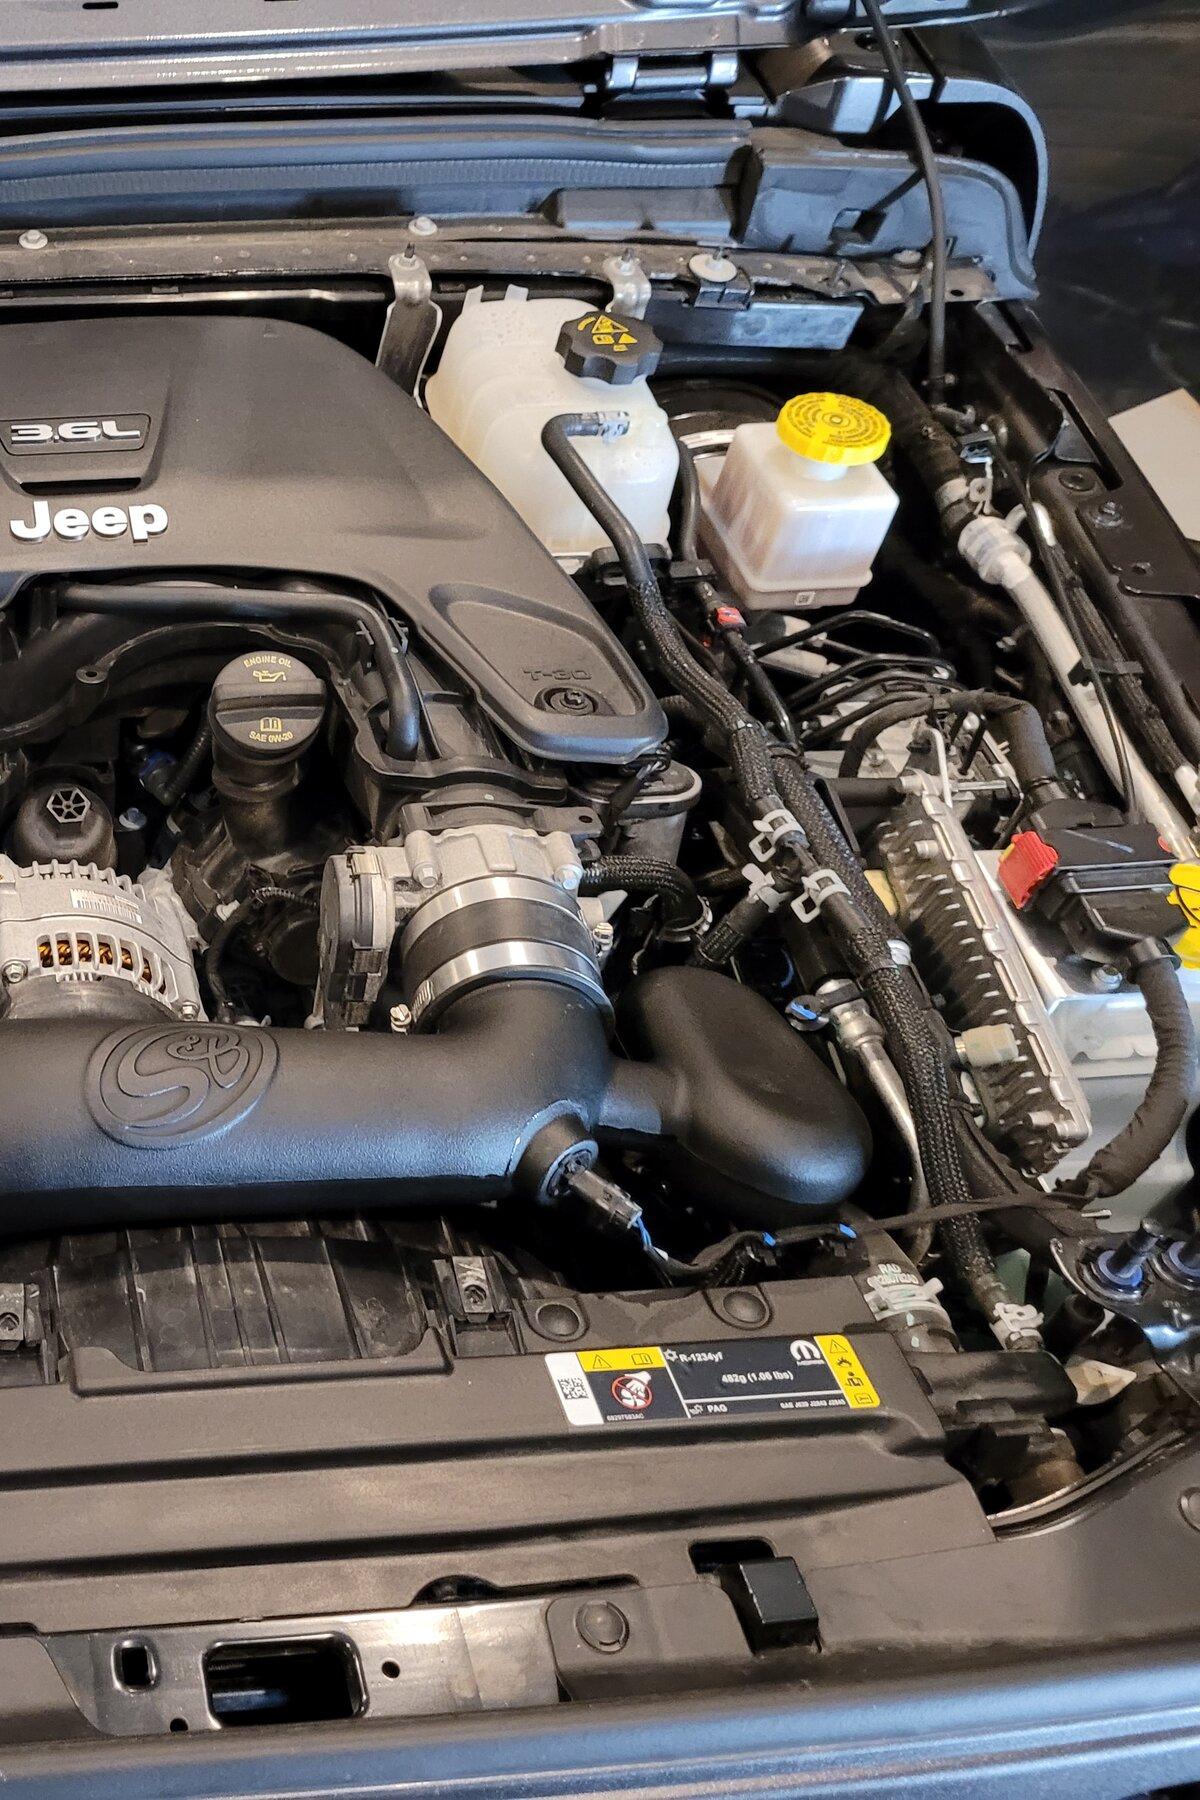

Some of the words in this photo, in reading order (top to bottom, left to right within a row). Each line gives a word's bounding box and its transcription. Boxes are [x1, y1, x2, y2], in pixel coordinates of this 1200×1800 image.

[10, 420, 141, 444] 3.6L
[9, 500, 169, 544] Jeep
[243, 655, 277, 668] ENGINE
[278, 657, 292, 668] OIL
[249, 730, 267, 743] SAE
[679, 1351, 724, 1364] R-1234yf
